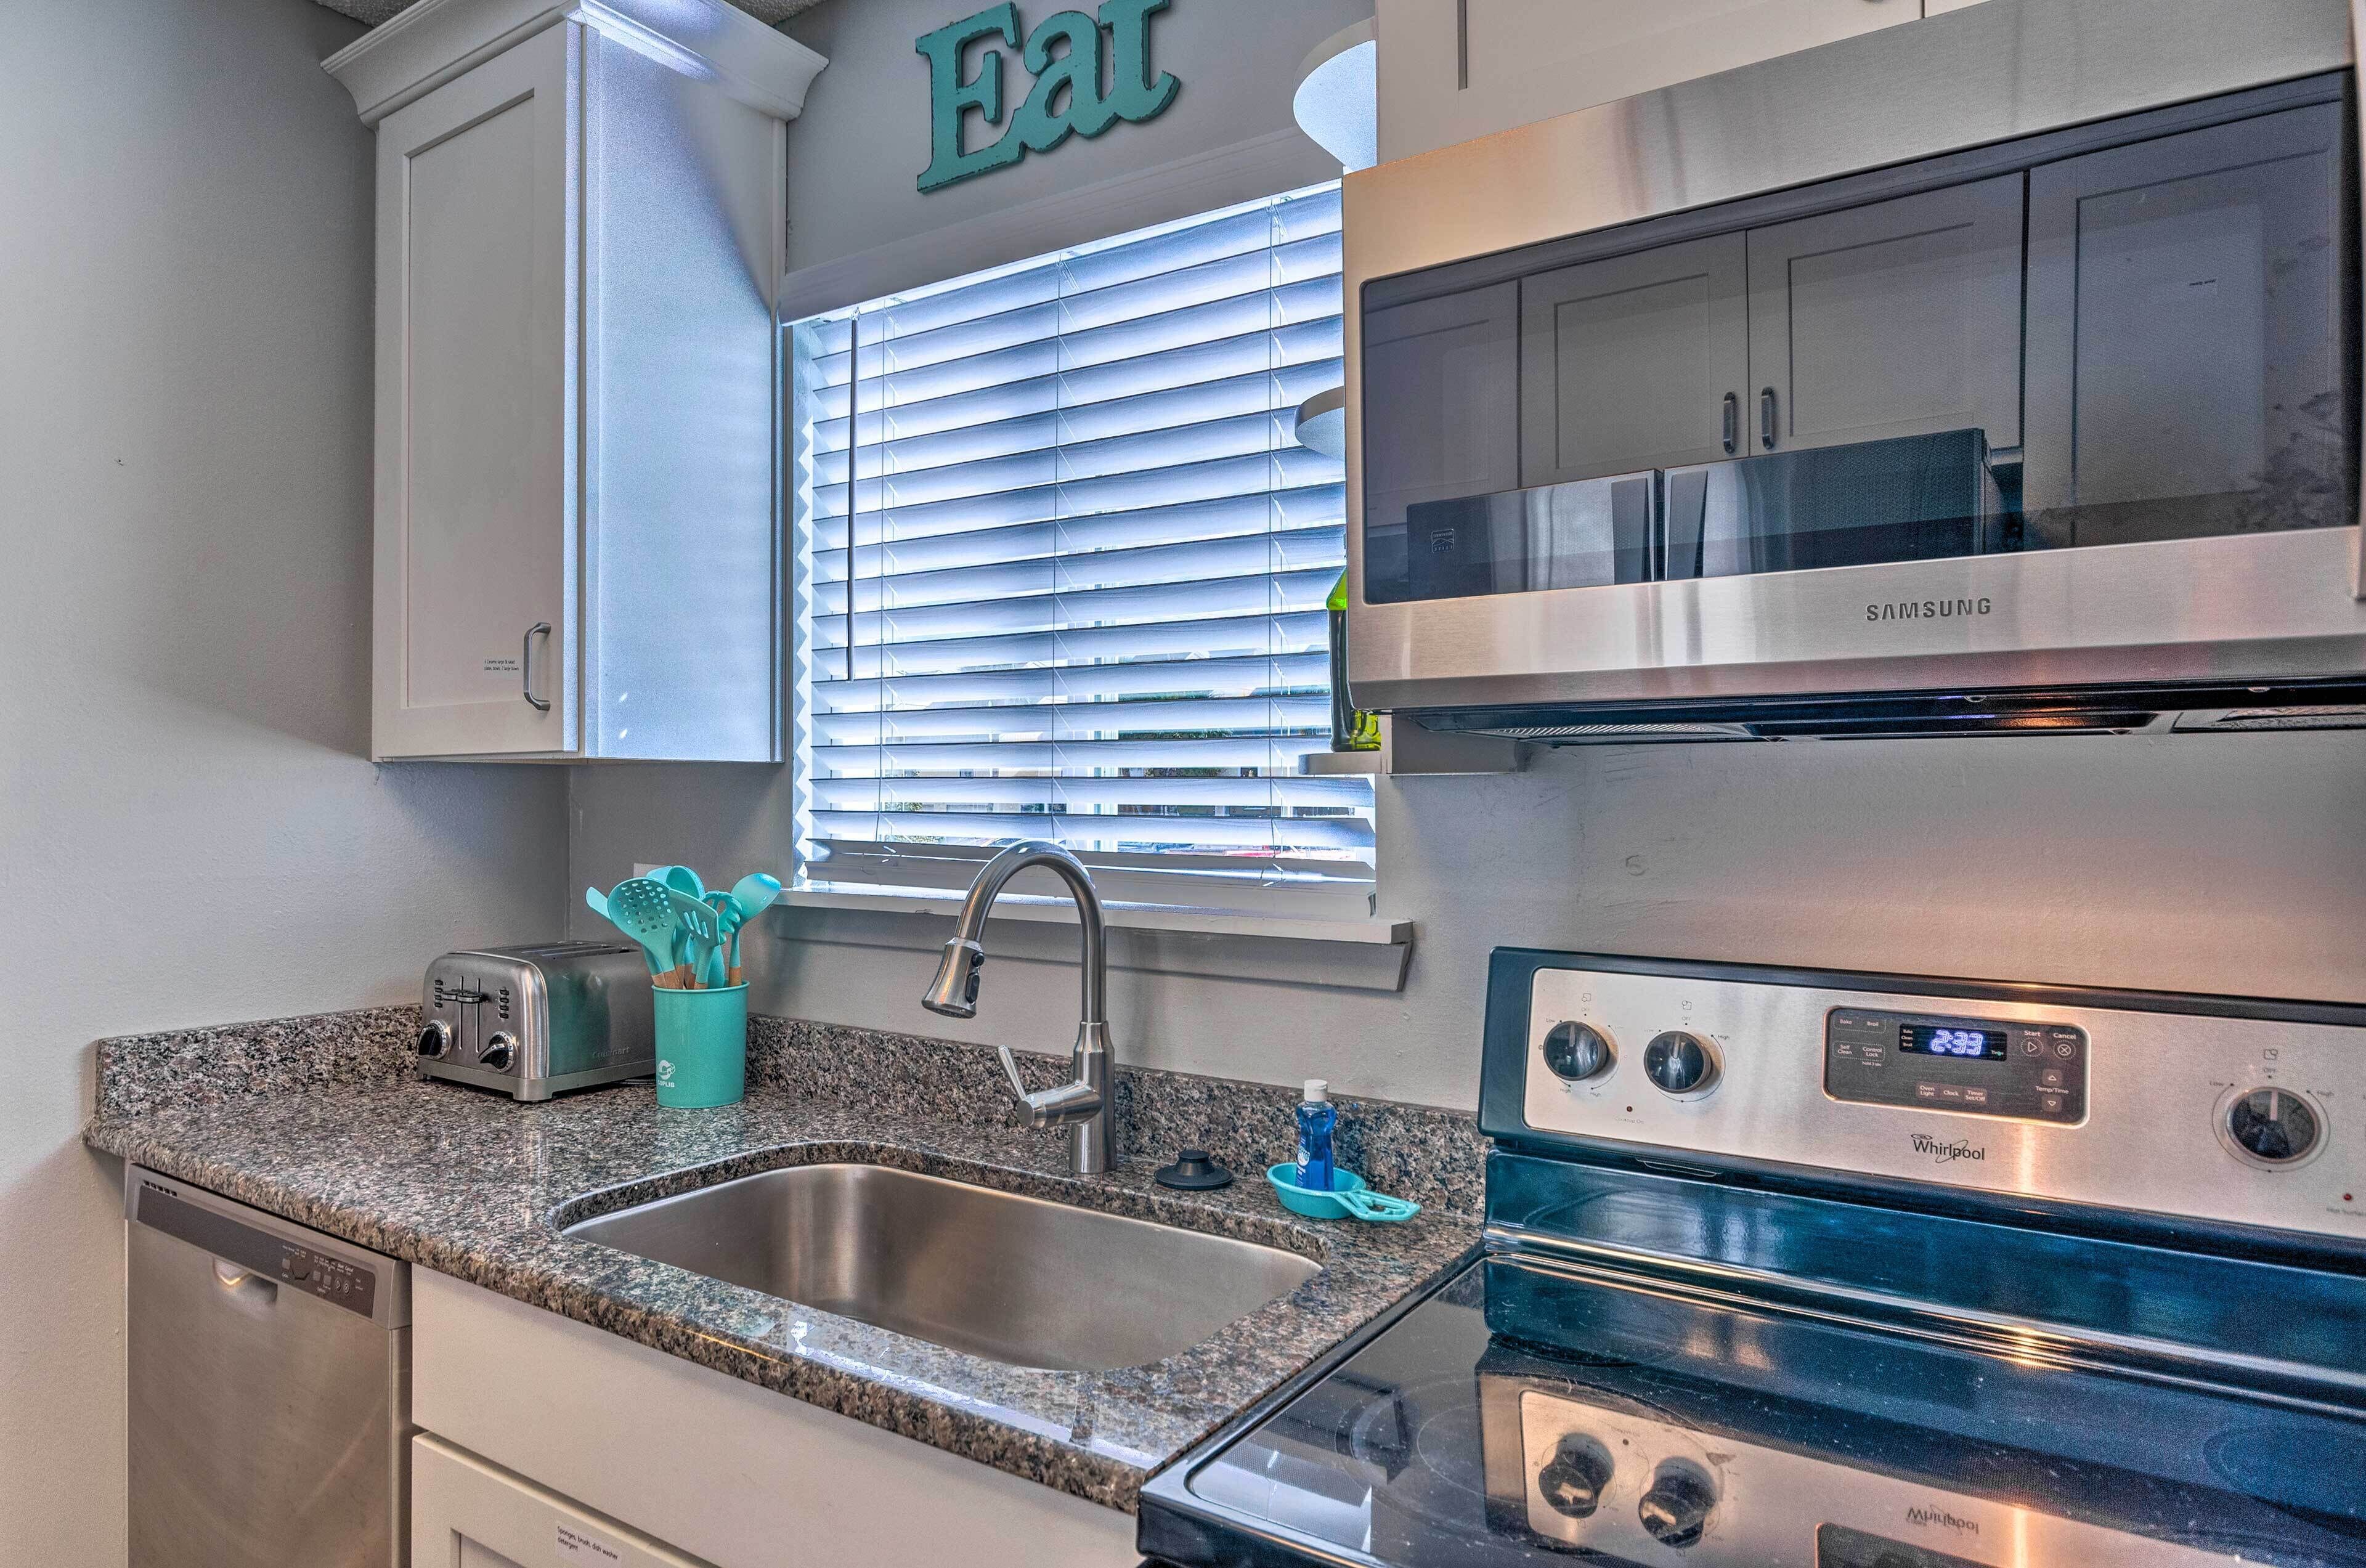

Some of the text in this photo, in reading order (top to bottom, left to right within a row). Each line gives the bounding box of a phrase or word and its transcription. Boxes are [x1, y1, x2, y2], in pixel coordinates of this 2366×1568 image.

[916, 0, 1181, 193] Eat
[1866, 598, 1991, 621] SAMSUNG
[2035, 1086, 2069, 1094] Temp/Time
[1913, 1139, 1985, 1161] Whirlpool
